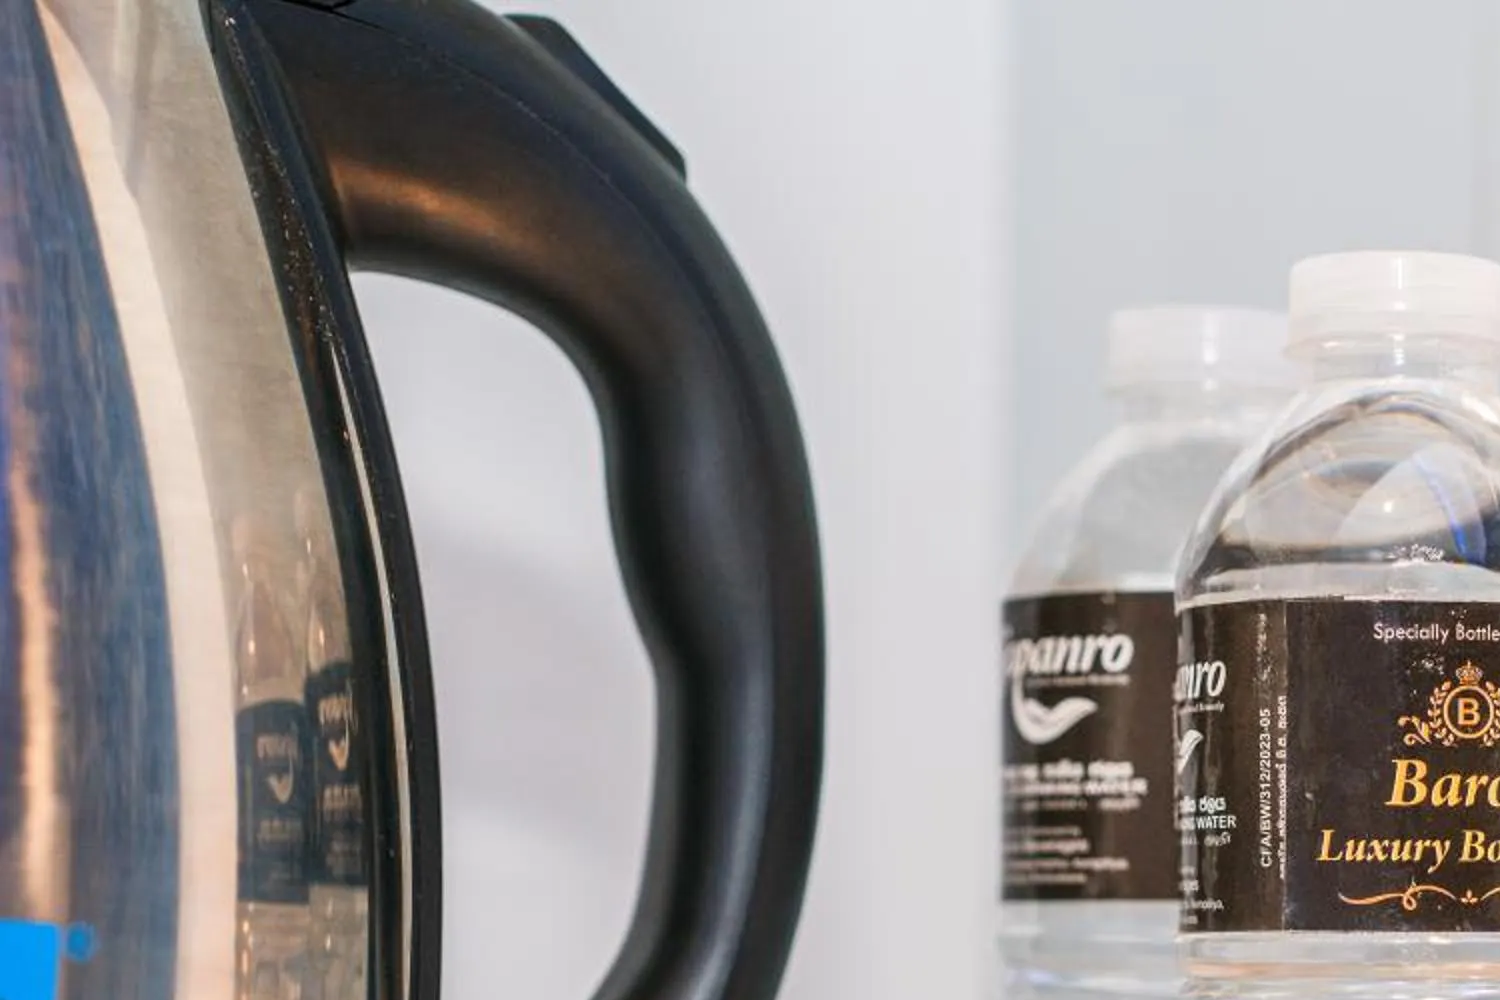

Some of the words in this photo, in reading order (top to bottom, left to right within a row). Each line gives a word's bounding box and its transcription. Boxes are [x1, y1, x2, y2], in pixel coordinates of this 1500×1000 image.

[1374, 621, 1449, 644] Specially
[1457, 698, 1480, 725] B
[1196, 815, 1236, 829] WATER
[1316, 830, 1450, 874] Luxury
